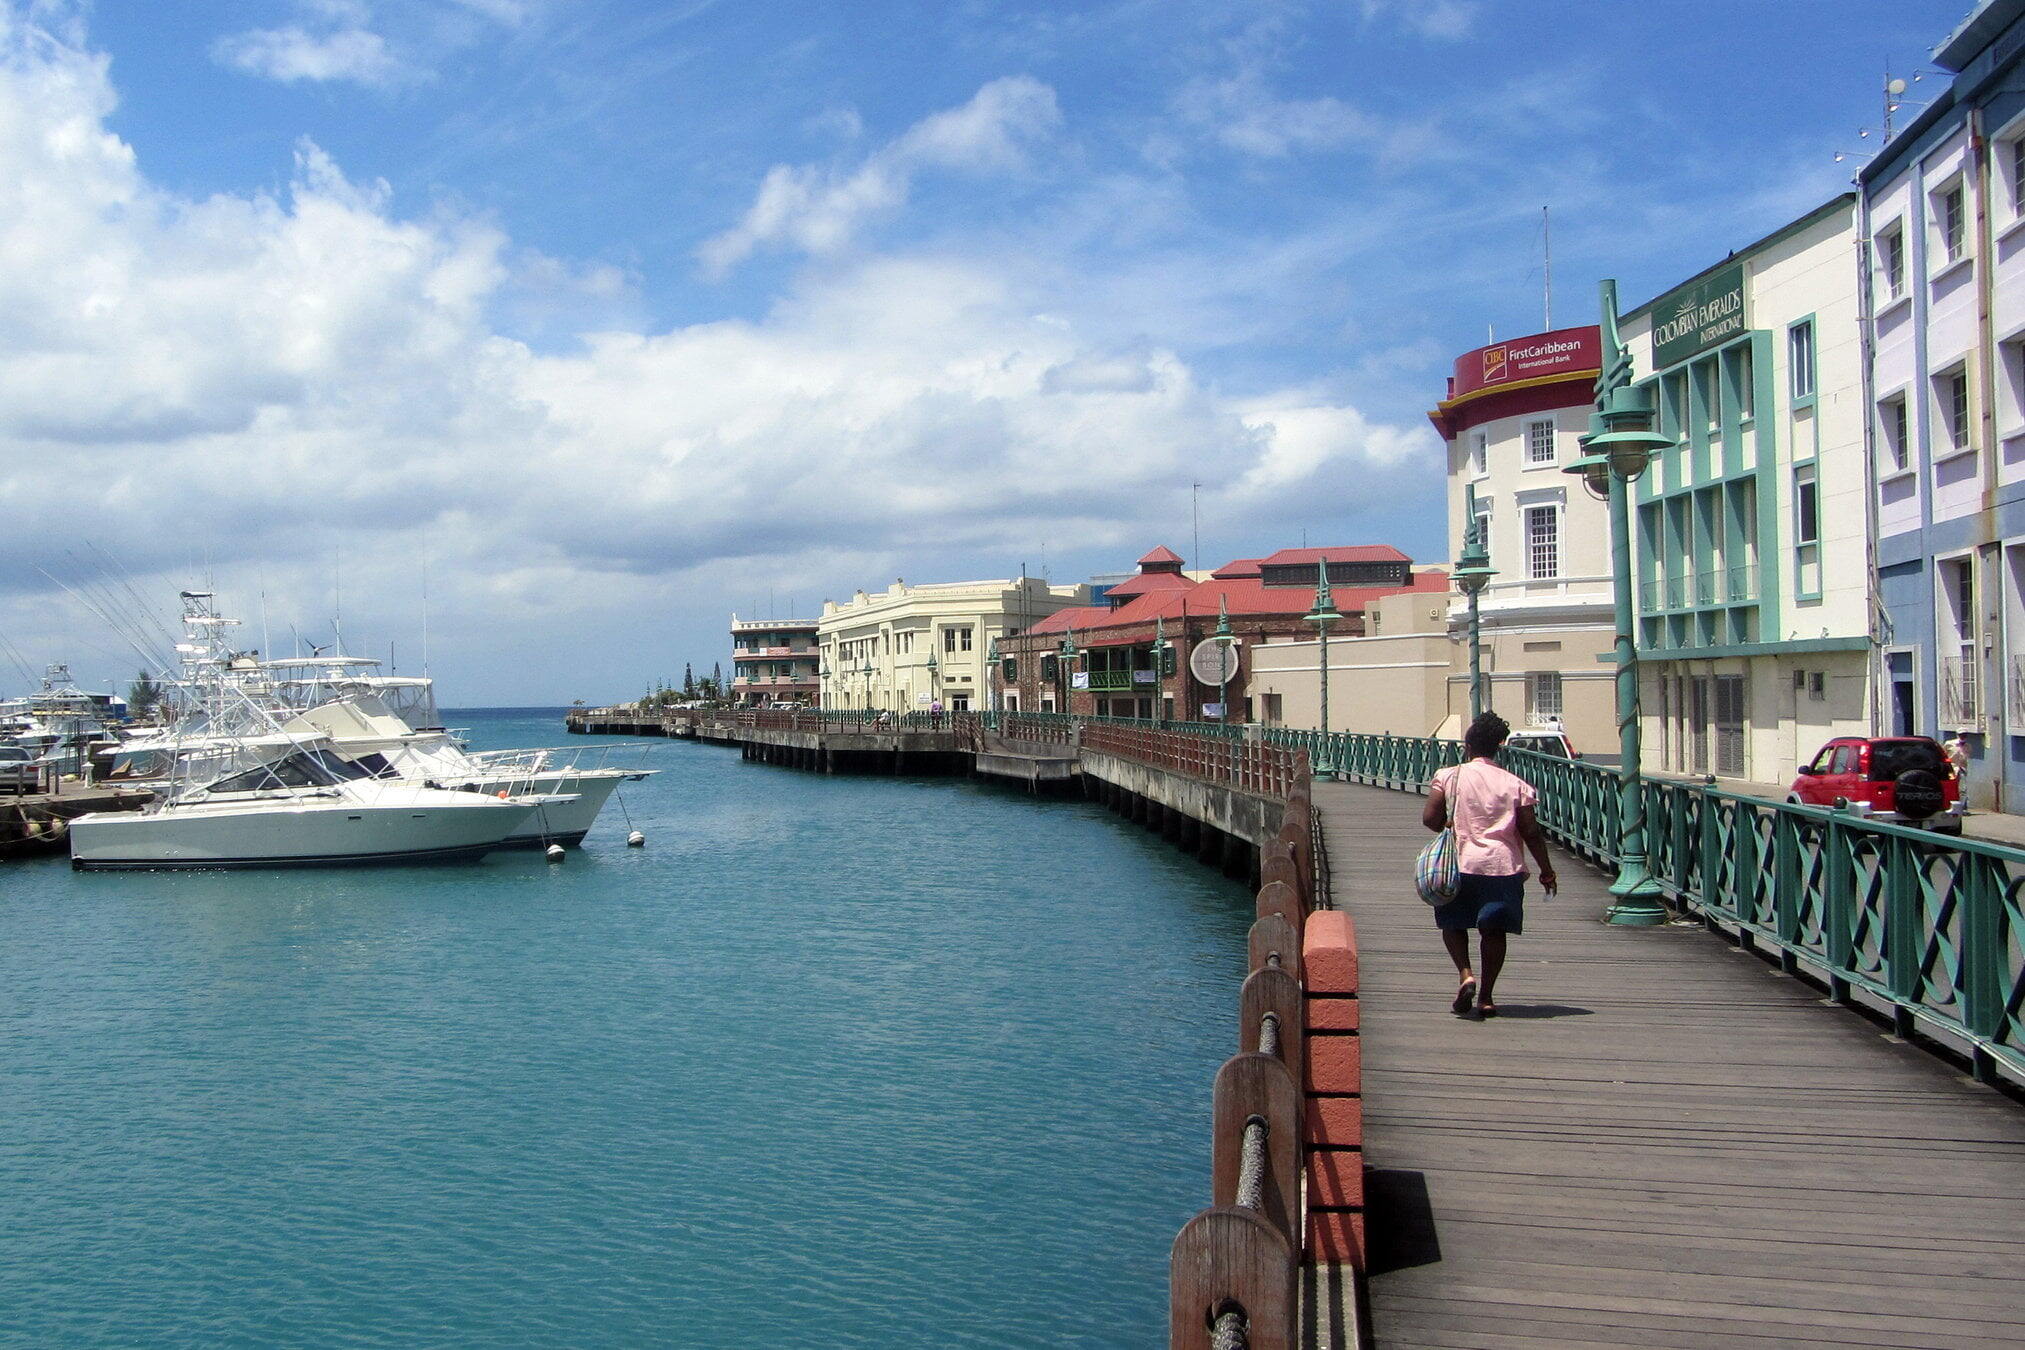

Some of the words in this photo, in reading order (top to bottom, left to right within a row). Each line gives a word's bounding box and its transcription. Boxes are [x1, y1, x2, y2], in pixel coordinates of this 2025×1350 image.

[1654, 312, 1698, 347] COLOMBIAN
[1699, 288, 1741, 327] EMERALDS
[1485, 350, 1504, 364] CIBC
[1509, 340, 1581, 361] FirstCaribbean
[1518, 357, 1554, 369] International
[1555, 354, 1571, 363] Bank
